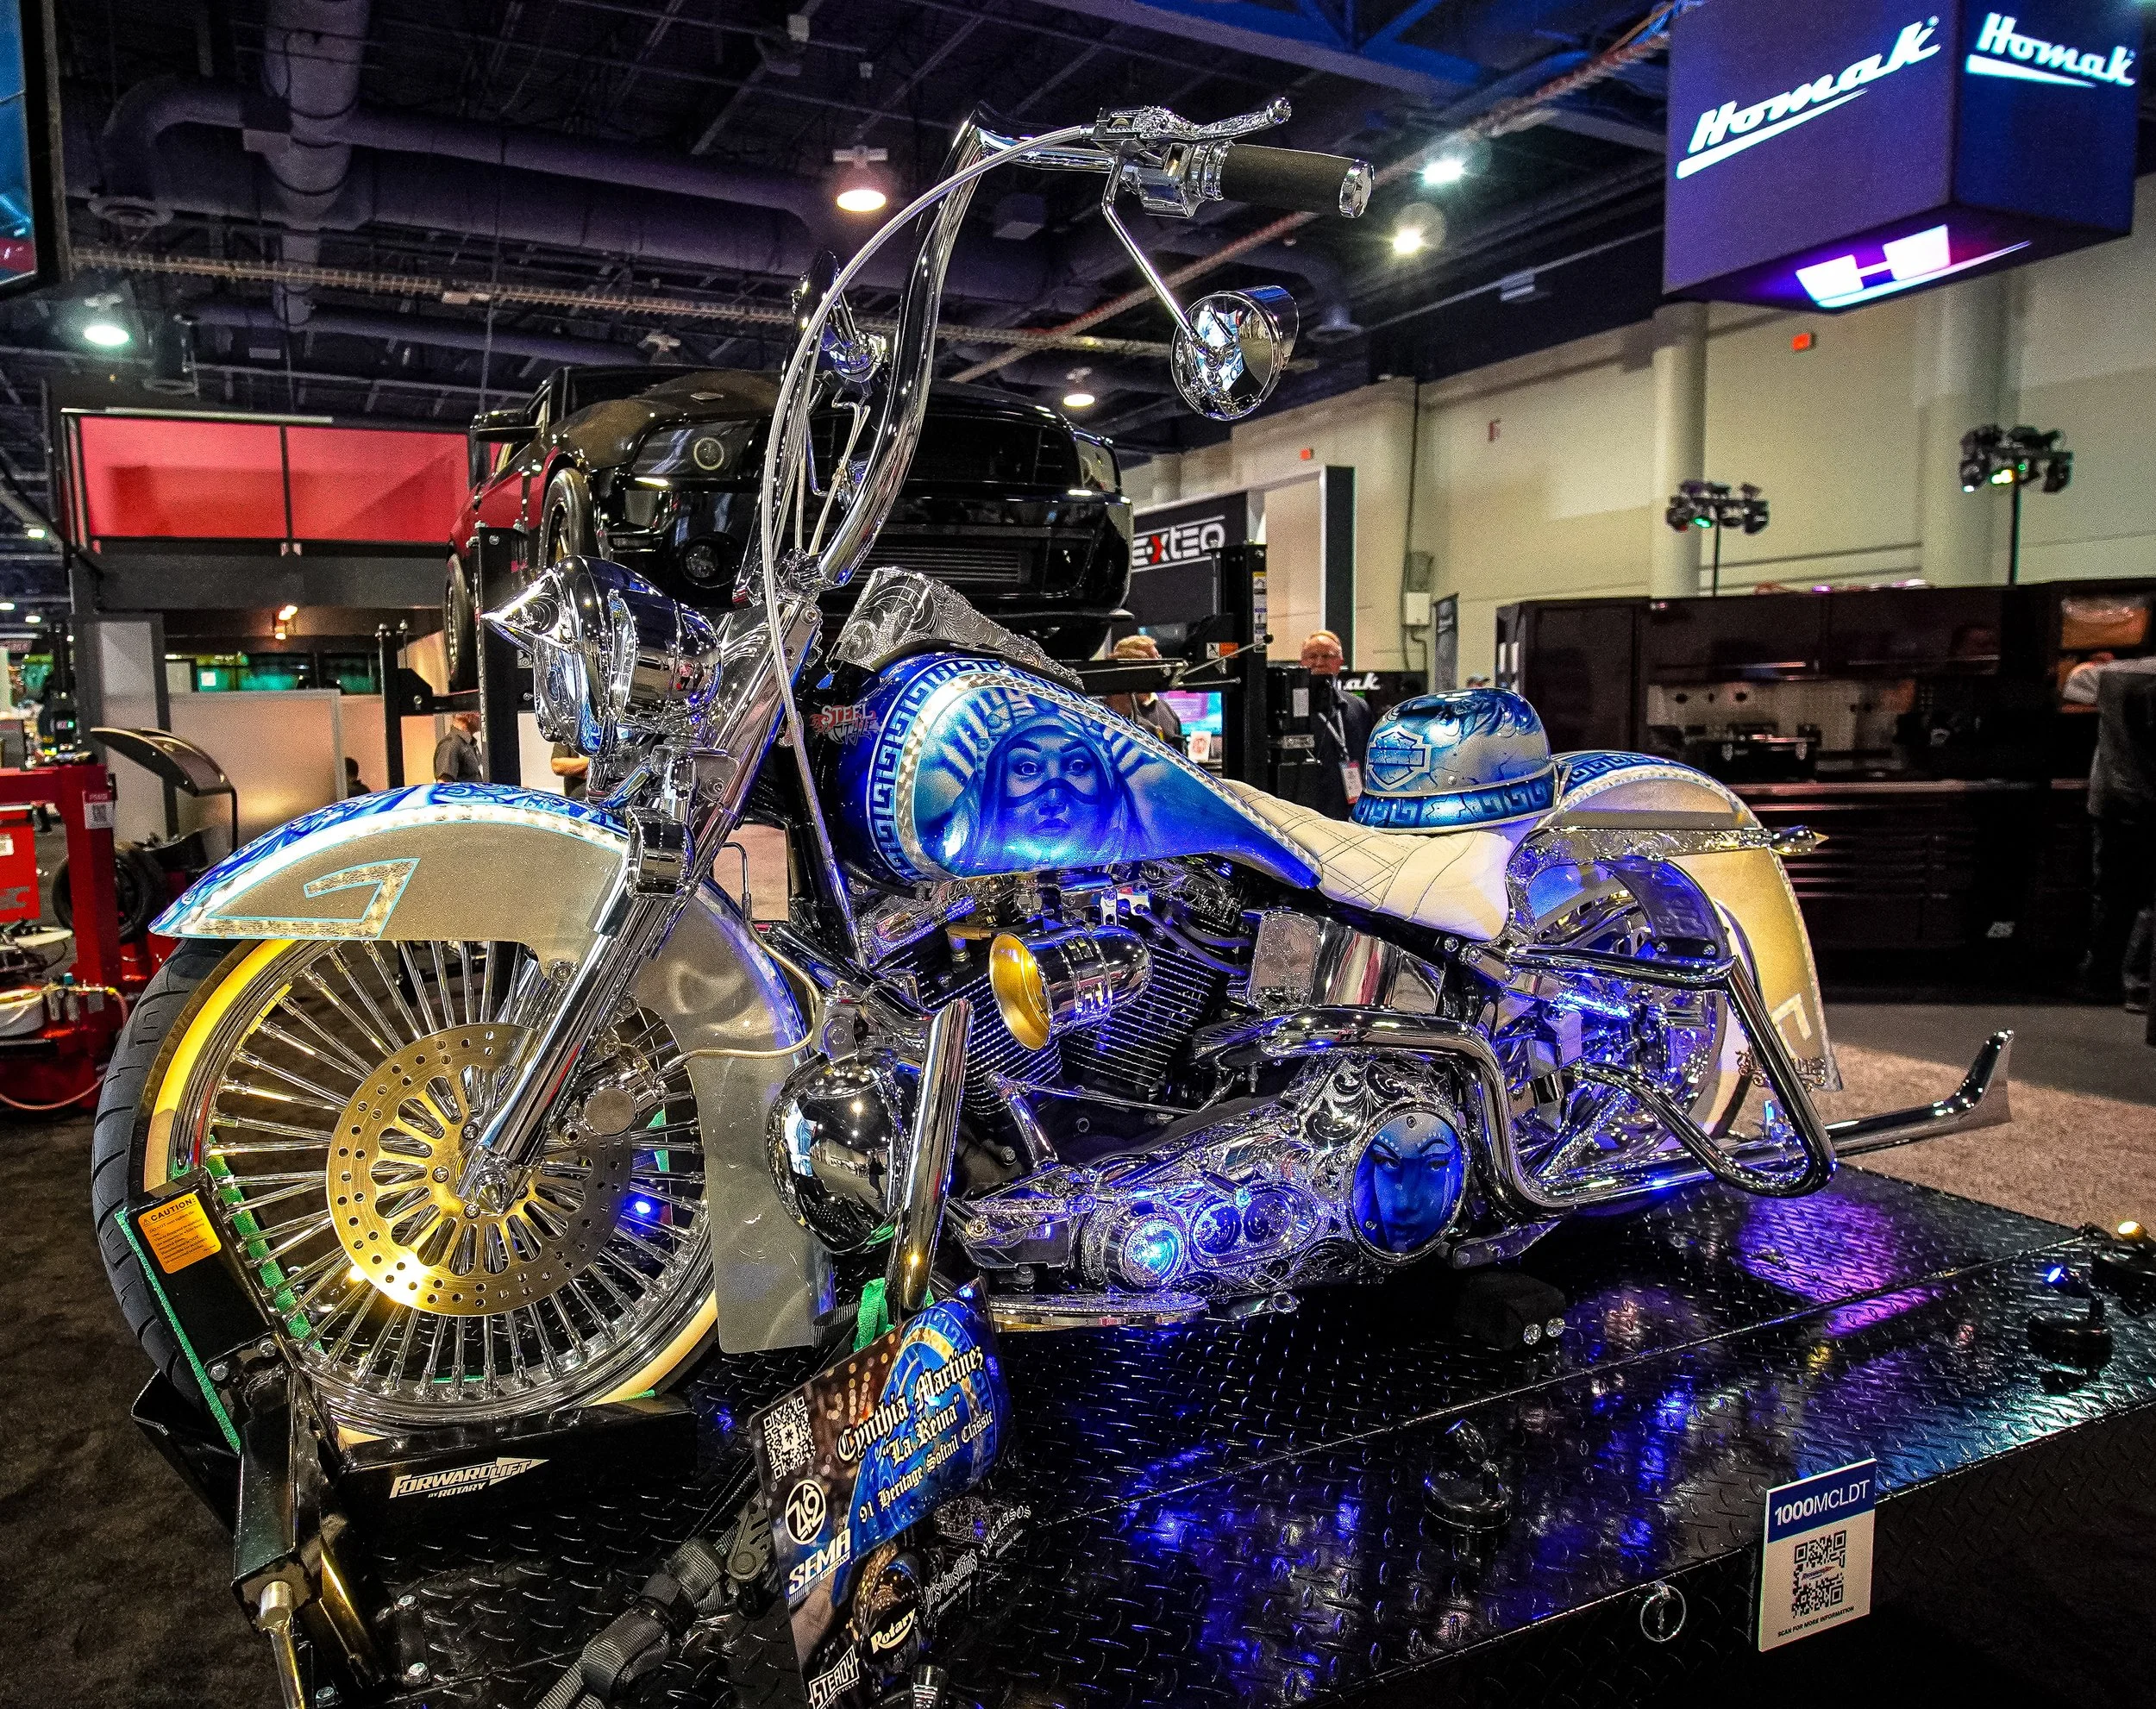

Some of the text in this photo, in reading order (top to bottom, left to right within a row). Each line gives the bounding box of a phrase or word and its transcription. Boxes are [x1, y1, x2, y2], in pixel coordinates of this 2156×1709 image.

[1977, 11, 2136, 87] Homak
[1687, 17, 1941, 155] Homak
[150, 1198, 197, 1222] CAUTION:
[837, 1345, 983, 1462] Cynthia Martinez
[437, 1481, 487, 1499] ROTARY
[859, 1409, 993, 1523] 91 Heritage Softail Classic
[1774, 1478, 1871, 1526] 1000MCLDT
[788, 1527, 851, 1595] SEMA
[822, 1555, 849, 1578] SHOW
[870, 1607, 916, 1655] Rotary
[1777, 1605, 1855, 1637] SCAN FOR MORE INFORMATION
[812, 1650, 855, 1709] STEADY
[837, 1680, 860, 1696] CYCLES
